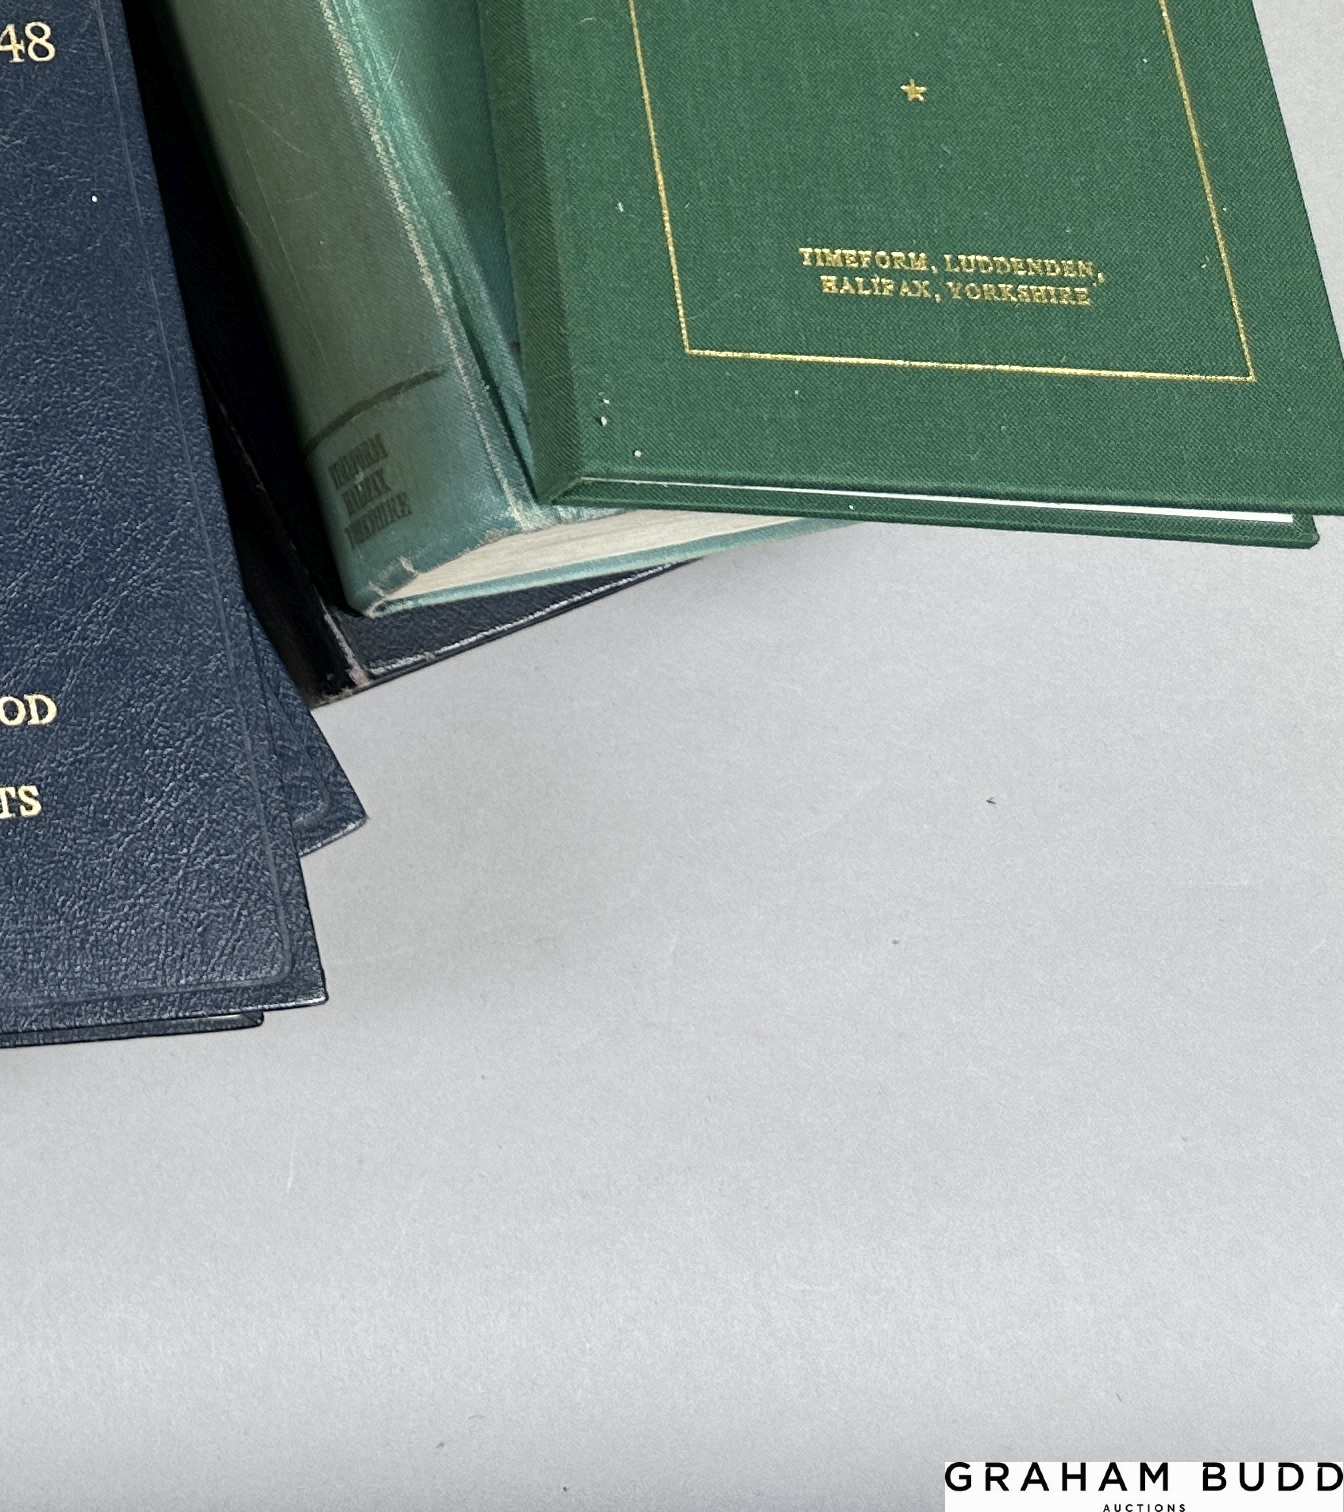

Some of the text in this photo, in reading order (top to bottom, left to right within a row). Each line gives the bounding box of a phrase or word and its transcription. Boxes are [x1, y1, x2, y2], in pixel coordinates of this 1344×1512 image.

[798, 246, 1106, 288] TIMEFORM, LUDDENDEN,
[819, 274, 1094, 307] HALIFAX, YORKSHIRE
